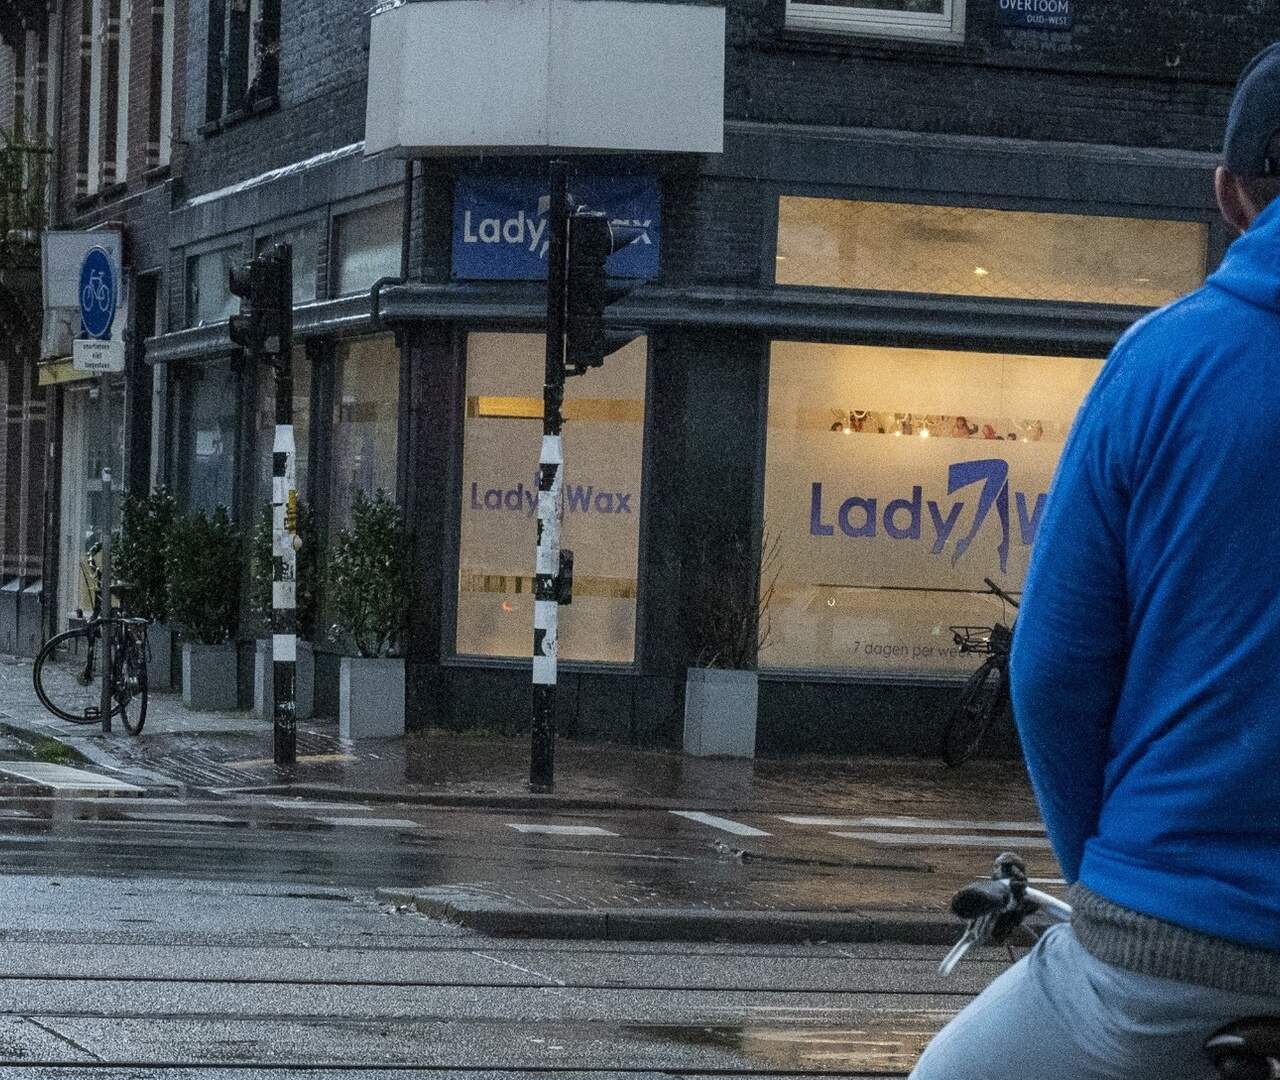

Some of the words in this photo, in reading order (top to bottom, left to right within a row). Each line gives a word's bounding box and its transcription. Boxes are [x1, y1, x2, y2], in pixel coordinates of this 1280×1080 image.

[1000, 0, 1069, 13] OVERTOOM
[1026, 14, 1067, 25] OUD-WEST
[464, 210, 547, 251] Lady
[471, 482, 540, 517] Lady
[566, 485, 631, 514] Wax
[810, 482, 964, 554] Lady
[854, 641, 861, 652] 7
[865, 640, 908, 658] dagen
[912, 645, 933, 659] per
